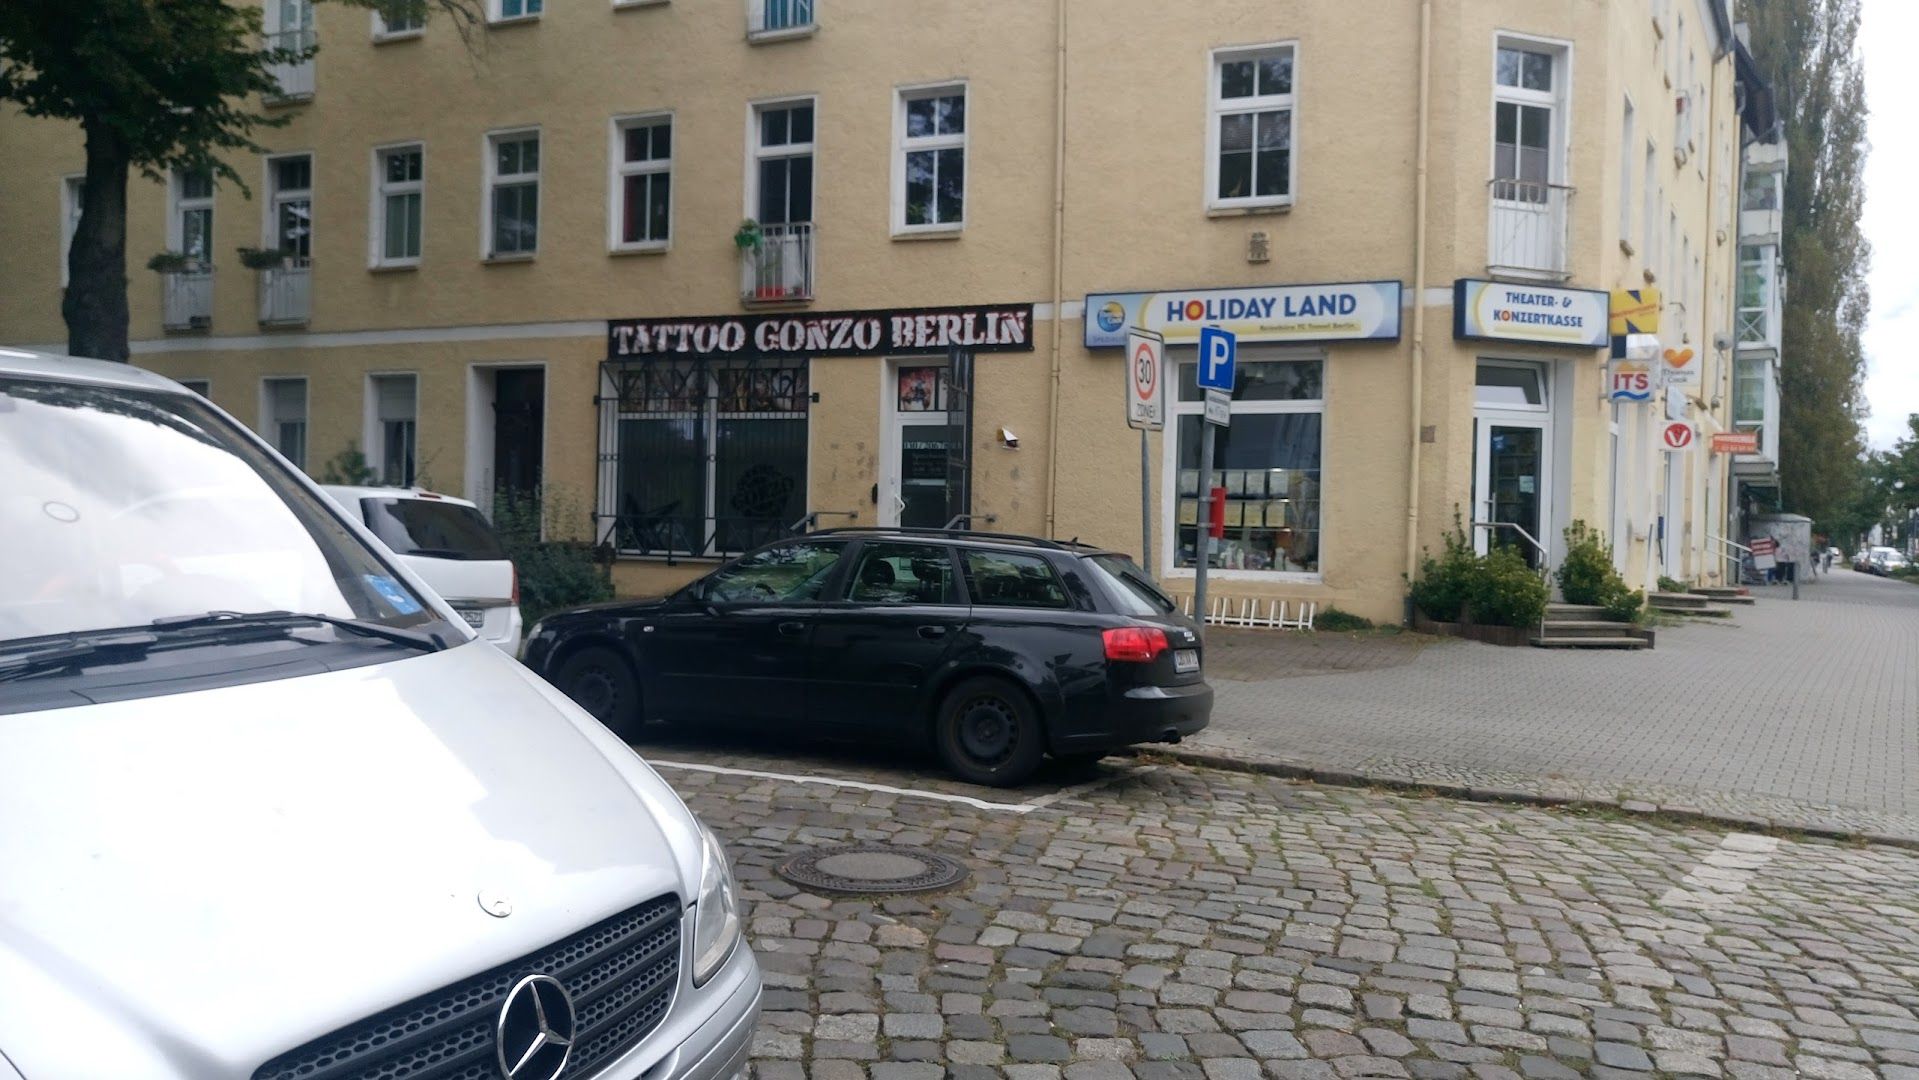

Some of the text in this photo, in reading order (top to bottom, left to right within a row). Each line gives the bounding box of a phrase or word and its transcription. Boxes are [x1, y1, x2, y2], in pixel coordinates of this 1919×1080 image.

[1167, 294, 1356, 321] HOLIDAY LAND
[1505, 292, 1572, 308] THEATER- &
[1493, 309, 1583, 327] KONZERTKASSE
[613, 312, 1027, 354] TATTOO GONZO BERLIN
[1208, 335, 1229, 380] P
[1138, 358, 1151, 384] 30
[1613, 373, 1648, 390] ITS
[1137, 403, 1155, 418] ZONE
